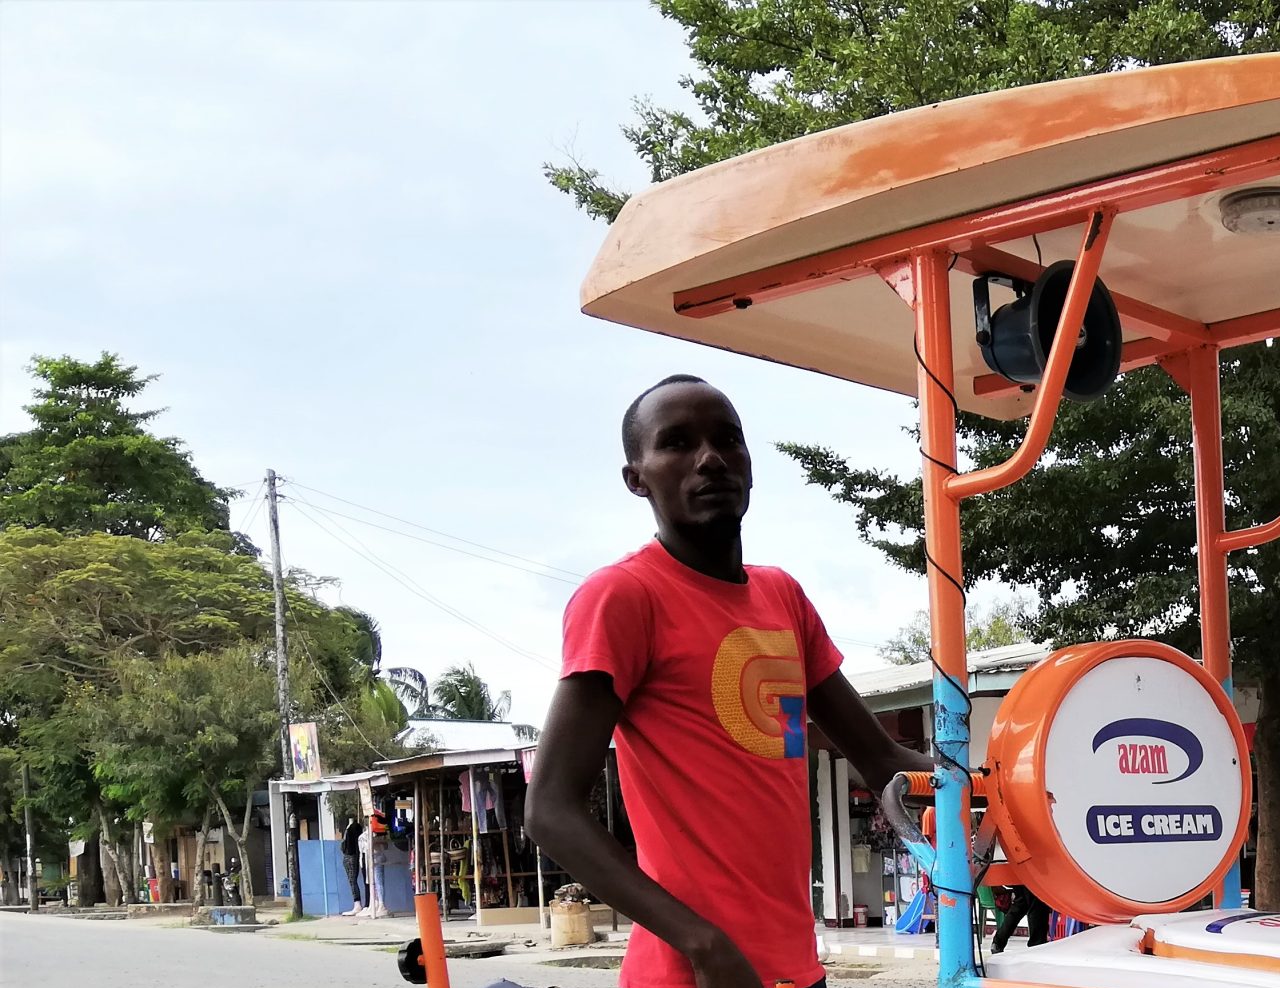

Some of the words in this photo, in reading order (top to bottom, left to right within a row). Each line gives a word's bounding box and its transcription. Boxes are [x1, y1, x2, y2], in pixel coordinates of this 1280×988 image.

[1118, 744, 1168, 773] azam
[1097, 815, 1134, 836] ICE
[1141, 814, 1214, 835] CREAM
